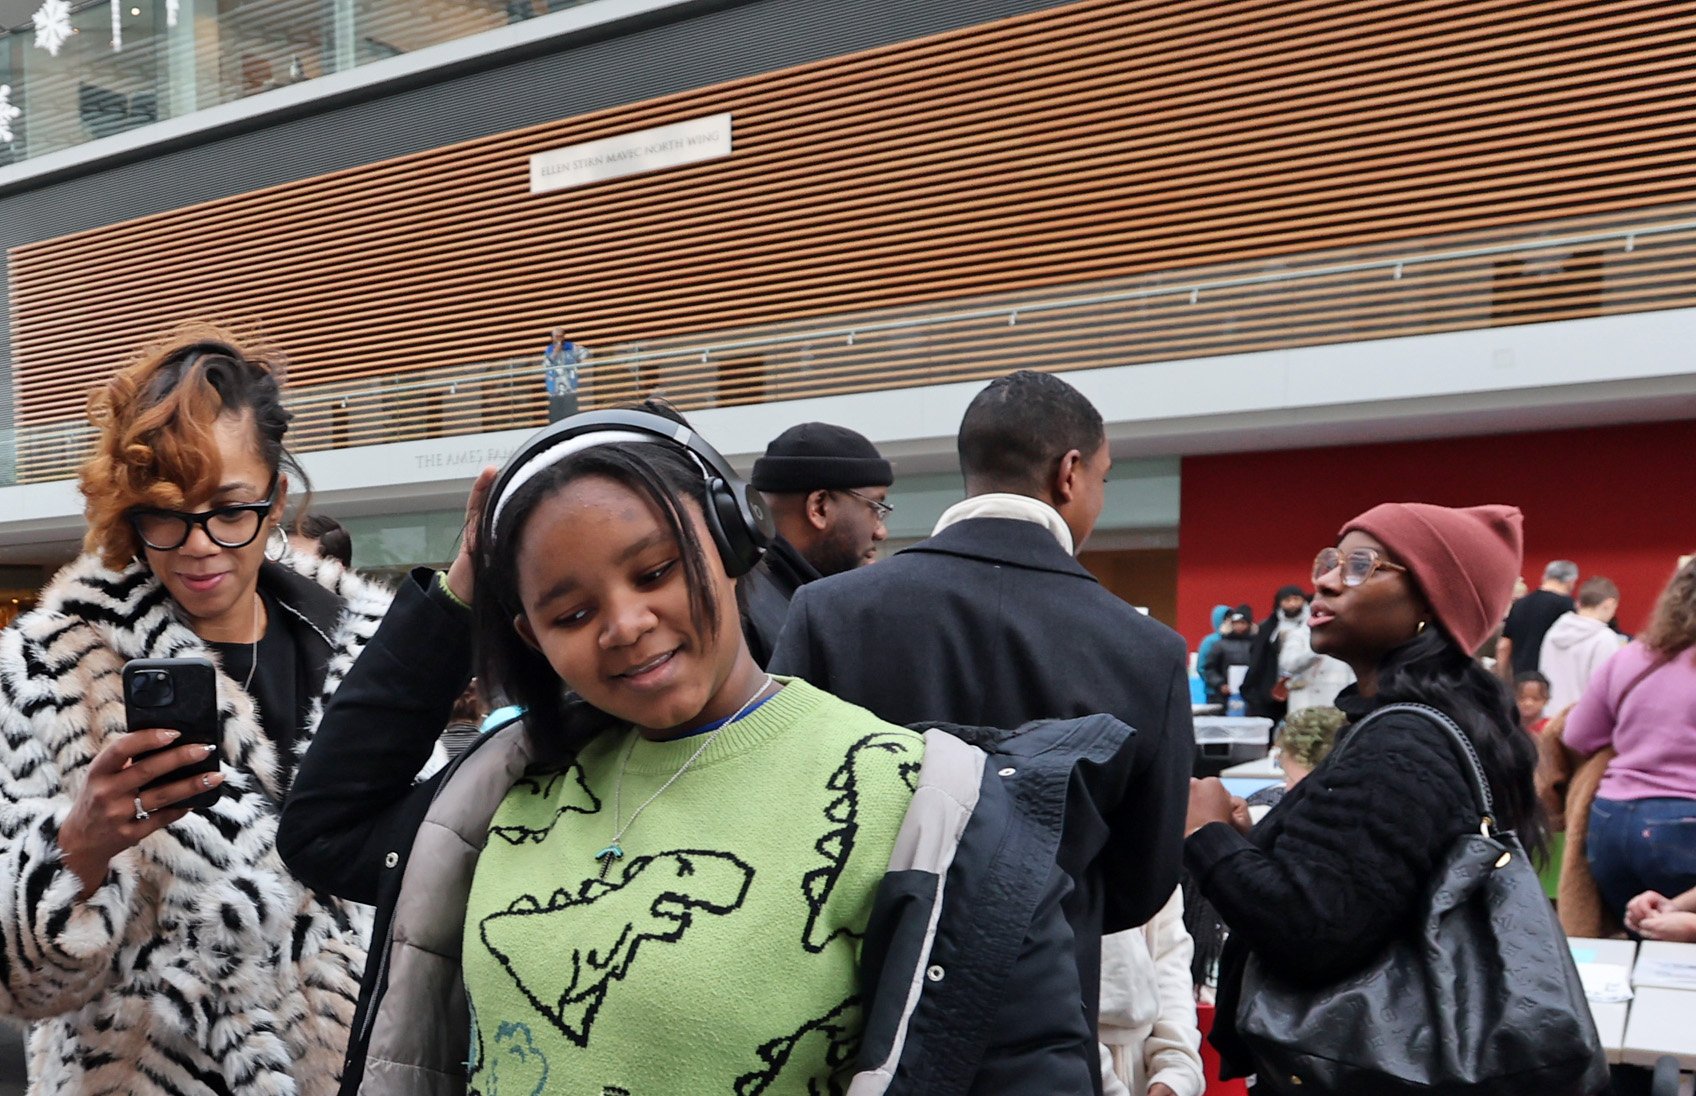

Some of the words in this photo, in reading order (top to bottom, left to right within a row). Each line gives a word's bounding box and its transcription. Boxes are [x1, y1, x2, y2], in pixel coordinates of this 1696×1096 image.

[541, 161, 570, 177] ELLEN
[573, 155, 603, 169] STIRN
[606, 148, 642, 163] MAVEC
[644, 138, 685, 154] NORTH
[687, 130, 720, 147] WING
[414, 453, 443, 469] THE
